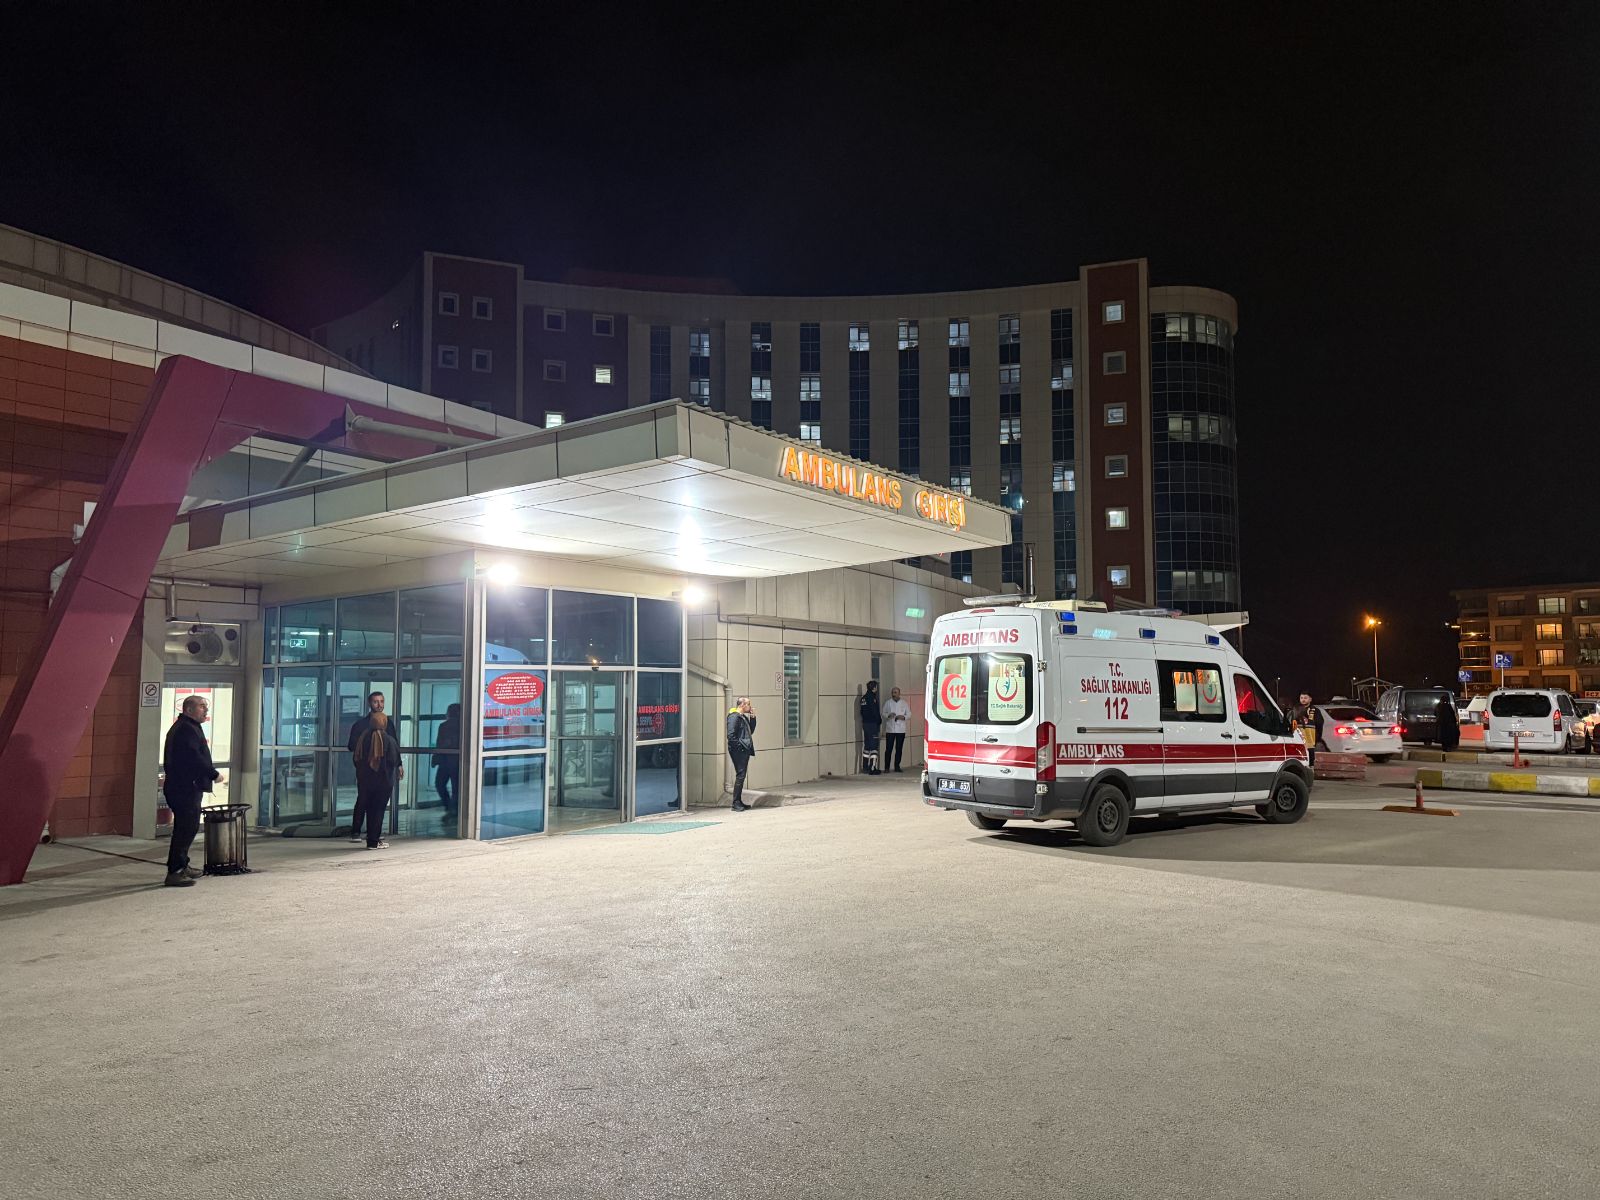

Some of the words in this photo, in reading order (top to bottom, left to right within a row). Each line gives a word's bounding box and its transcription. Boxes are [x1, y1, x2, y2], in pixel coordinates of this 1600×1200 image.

[779, 446, 902, 510] AMBULANS
[943, 628, 1019, 647] AMBULANS
[1495, 654, 1503, 664] P
[1109, 662, 1124, 677] T.C.
[949, 685, 967, 698] 112
[1080, 675, 1110, 694] SAĞLIK
[1111, 678, 1152, 695] BAKANLIĞI
[484, 708, 521, 718] AMBULANS
[1104, 696, 1129, 720] 112
[1059, 744, 1125, 758] AMBULANS
